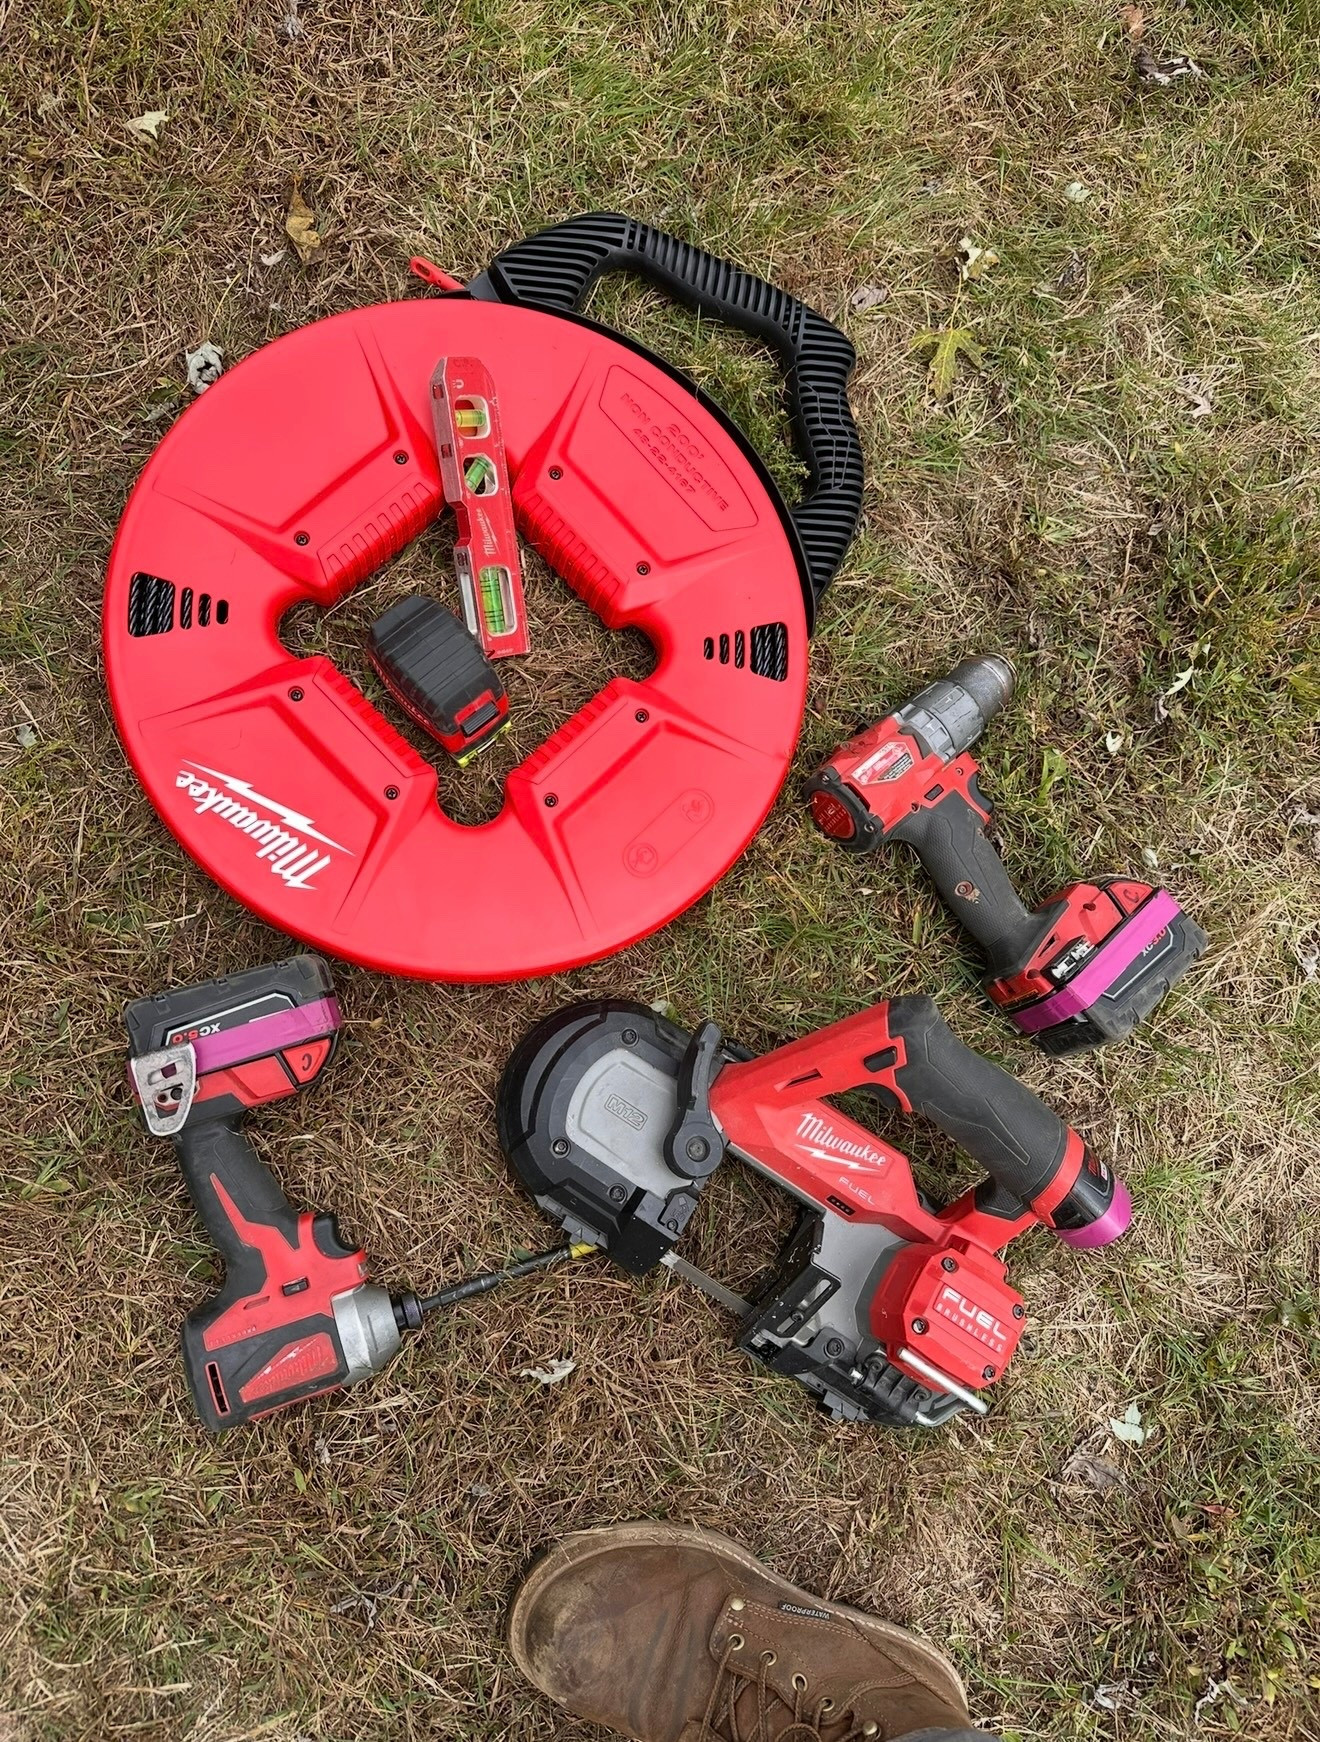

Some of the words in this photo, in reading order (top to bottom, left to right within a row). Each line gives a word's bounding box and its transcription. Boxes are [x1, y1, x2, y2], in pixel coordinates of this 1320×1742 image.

[620, 393, 651, 425] NON
[651, 425, 729, 511] CONDUCTIVE
[475, 508, 497, 557] Milwaukee
[176, 770, 331, 890] Milwaukee
[172, 1022, 221, 1044] XC5.0
[607, 1096, 645, 1127] M12
[795, 1112, 887, 1167] Milwaukee
[838, 1176, 876, 1206] FUEL
[935, 1302, 1004, 1353] BRUSHLESS
[942, 1287, 1007, 1341] FUEL
[781, 1603, 830, 1620] WATERPROOF
